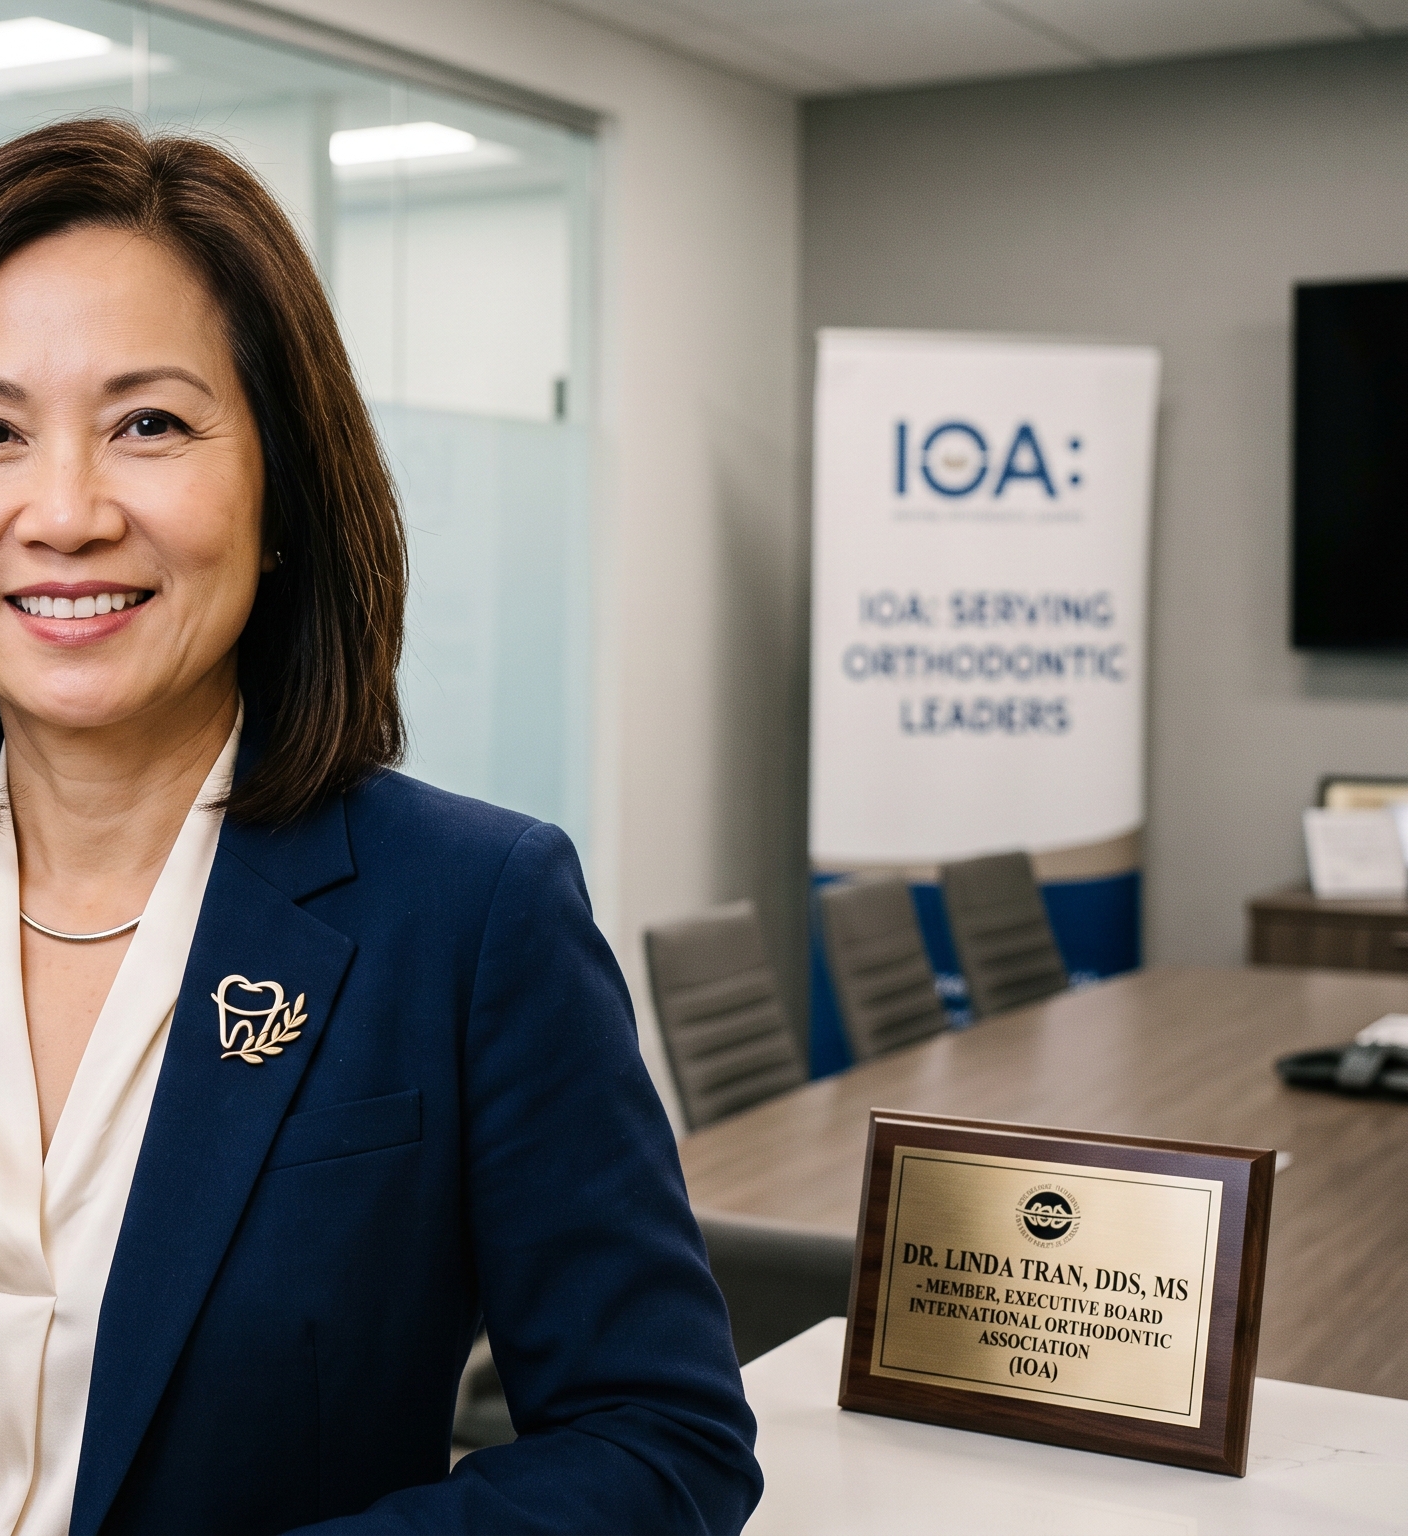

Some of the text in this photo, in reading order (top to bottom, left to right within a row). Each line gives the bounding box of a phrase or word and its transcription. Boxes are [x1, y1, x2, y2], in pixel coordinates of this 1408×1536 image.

[895, 420, 1083, 498] IOA:
[949, 592, 1114, 627] SERVING
[842, 644, 1127, 682] ORTHODONTIC
[900, 697, 1070, 734] LEADERS
[902, 1243, 1189, 1301] DR. LINDA TRAN, DDS, MS
[925, 1278, 1000, 1305] MEMBER,
[1004, 1289, 1100, 1317] EXECUTIVE
[1104, 1304, 1163, 1325] BOARD
[909, 1297, 1173, 1349] INTERNATIONAL ORTHODONTIC
[978, 1330, 1090, 1360] ASSOCIATION
[1009, 1356, 1058, 1383] (IOA)
